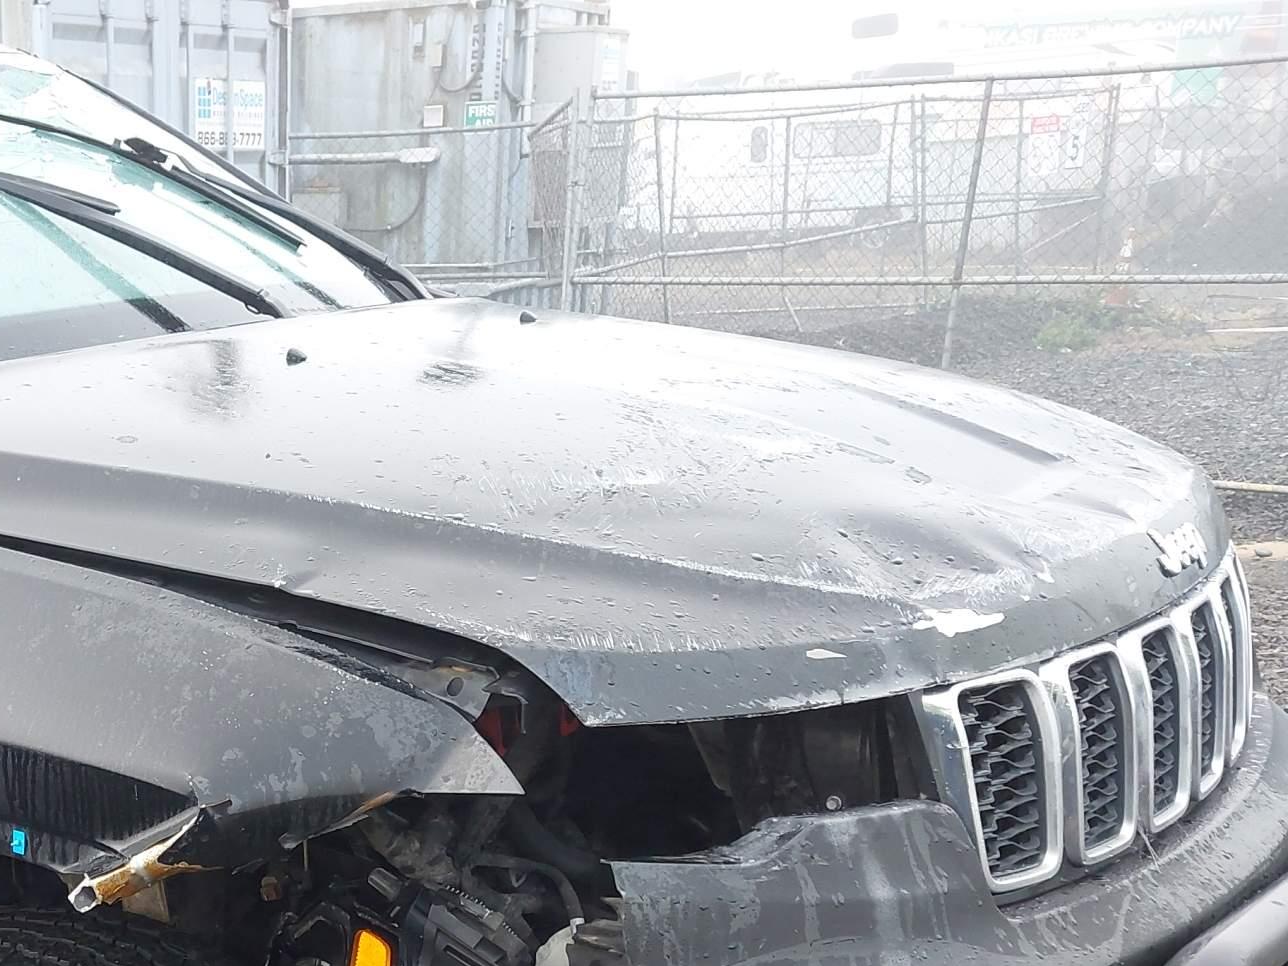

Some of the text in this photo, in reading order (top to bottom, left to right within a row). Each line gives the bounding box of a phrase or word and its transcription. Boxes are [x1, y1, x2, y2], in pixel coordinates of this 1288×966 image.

[1137, 14, 1240, 36] COMPANY
[213, 87, 263, 110] DesnSpace
[468, 104, 497, 118] FIRS
[1068, 135, 1079, 161] 5
